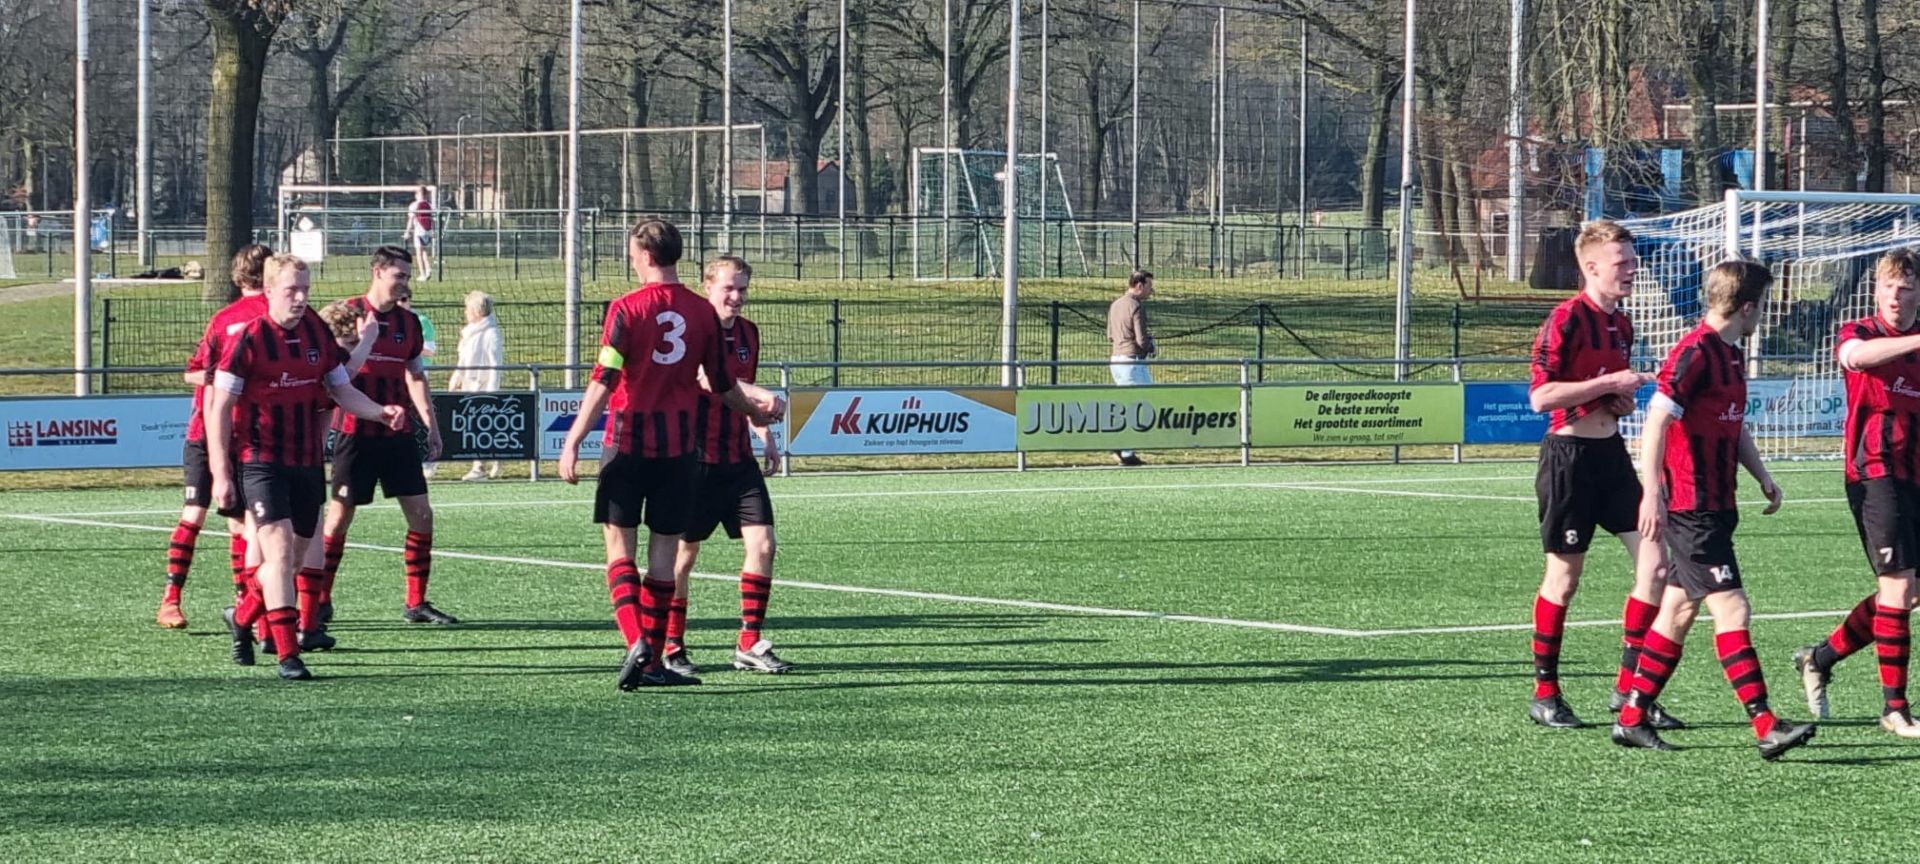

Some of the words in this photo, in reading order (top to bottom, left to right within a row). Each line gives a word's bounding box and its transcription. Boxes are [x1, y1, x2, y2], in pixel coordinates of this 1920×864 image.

[652, 311, 687, 365] 3
[1305, 390, 1319, 401] De
[1322, 389, 1412, 404] allergoedkoopste
[1023, 400, 1156, 434] JUMBO
[1157, 405, 1237, 435] Kuipers
[1318, 404, 1332, 415] De
[1334, 403, 1362, 415] beste
[1365, 403, 1400, 415] service
[36, 419, 118, 438] LANSING
[865, 411, 970, 434] KUIPHUIS
[1294, 418, 1313, 429] Het
[1315, 418, 1359, 432] grootste
[1361, 416, 1423, 428] assortiment
[462, 429, 524, 449] hoes.
[1880, 547, 1893, 563] 7
[1710, 565, 1733, 583] 14
